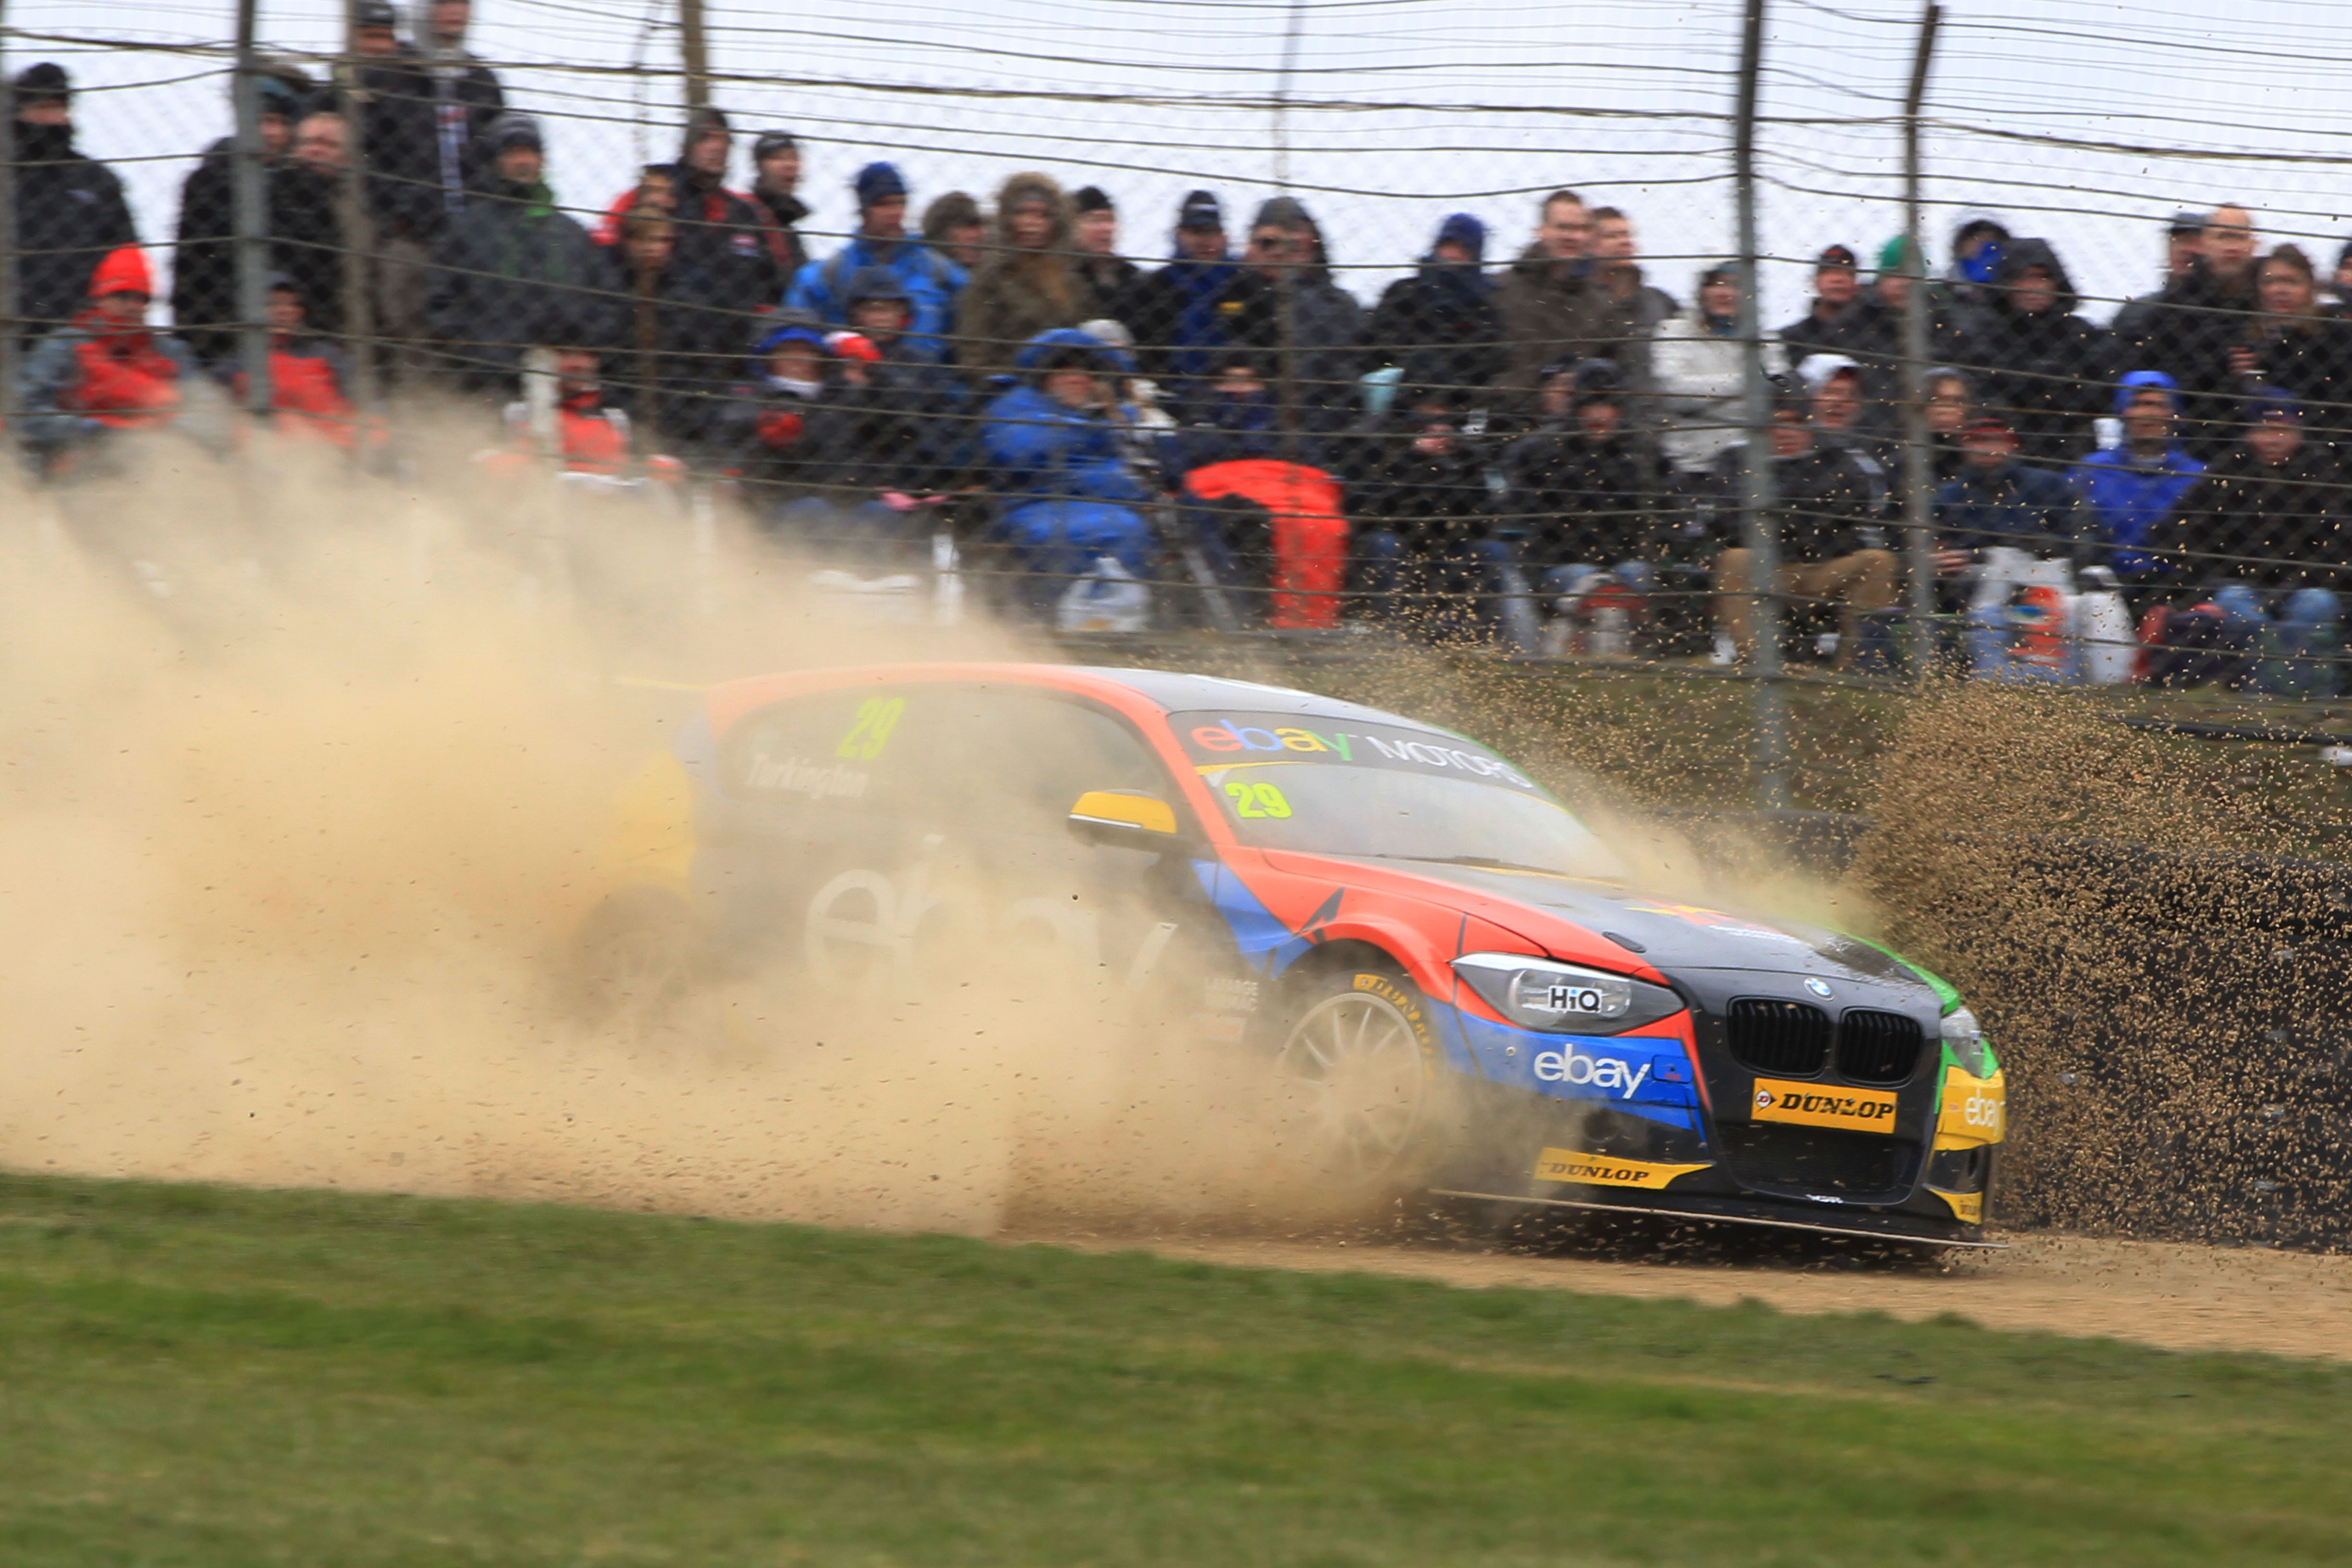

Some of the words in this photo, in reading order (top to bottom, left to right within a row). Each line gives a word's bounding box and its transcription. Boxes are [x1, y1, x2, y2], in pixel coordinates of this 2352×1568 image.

[836, 696, 906, 760] 29
[1191, 720, 1352, 761] ebay
[1226, 783, 1292, 819] 29
[1550, 987, 1600, 1011] HiQ
[1534, 1043, 1652, 1099] ebay
[1779, 1093, 1895, 1120] DUNLOP
[1548, 1163, 1651, 1182] DUNLOP
